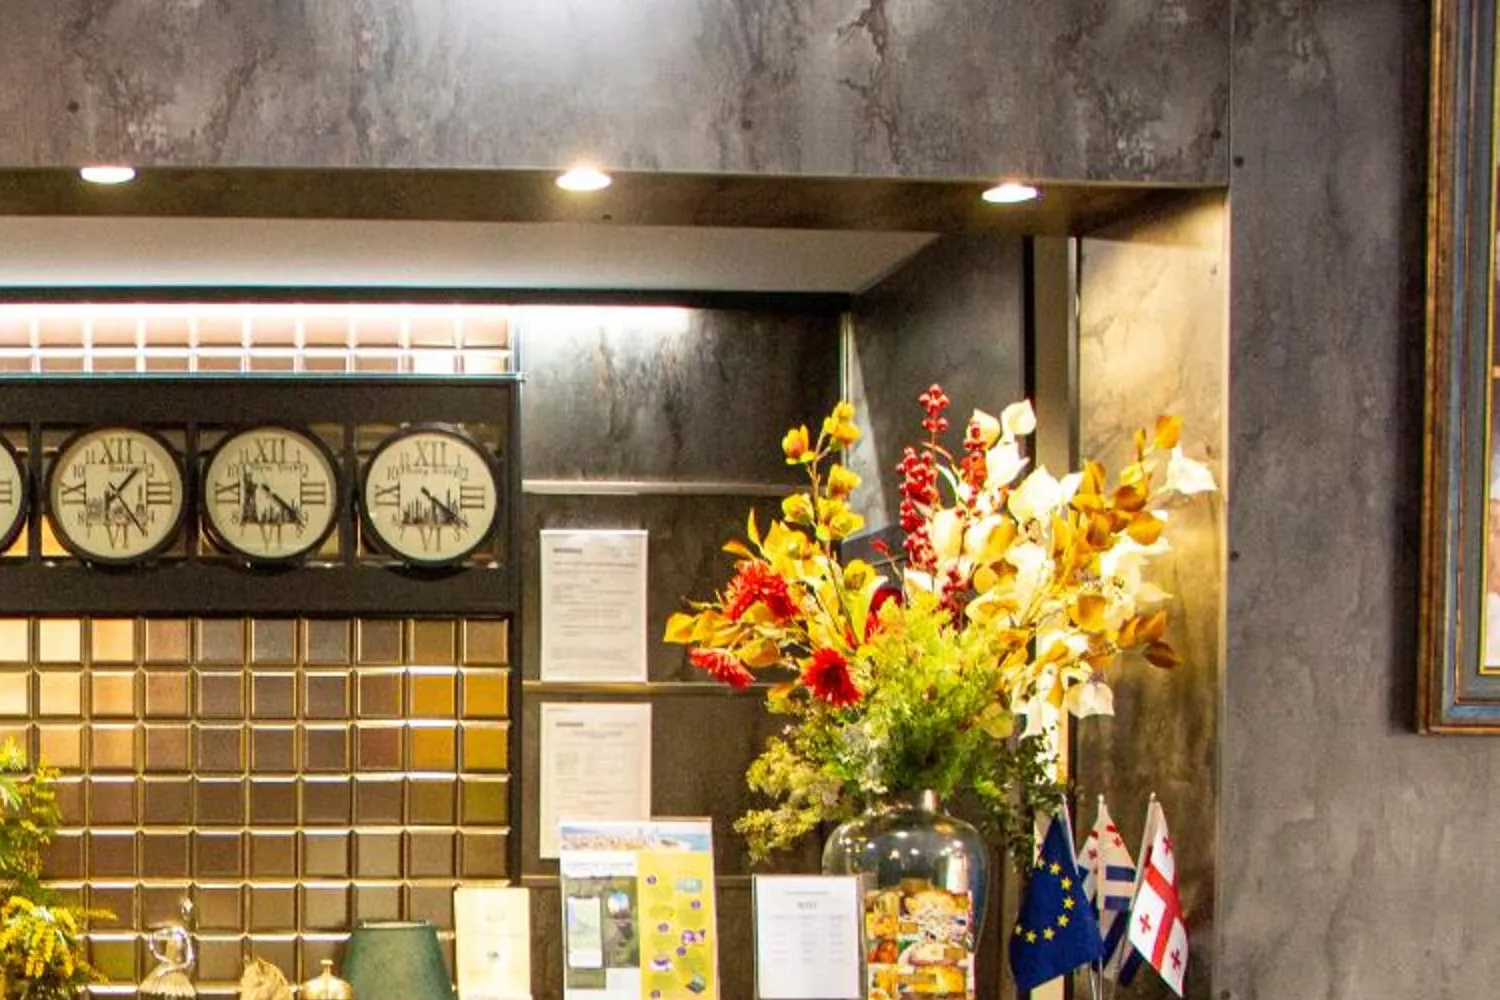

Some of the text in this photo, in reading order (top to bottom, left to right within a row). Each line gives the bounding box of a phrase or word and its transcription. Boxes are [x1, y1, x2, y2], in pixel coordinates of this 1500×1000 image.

[100, 437, 134, 464] XII
[254, 437, 287, 464] XII
[414, 440, 448, 467] XII
[146, 481, 173, 506] III
[300, 481, 327, 506] III
[459, 484, 486, 510] III
[102, 522, 130, 550] VI
[258, 522, 283, 551] VI
[418, 523, 443, 553] VI
